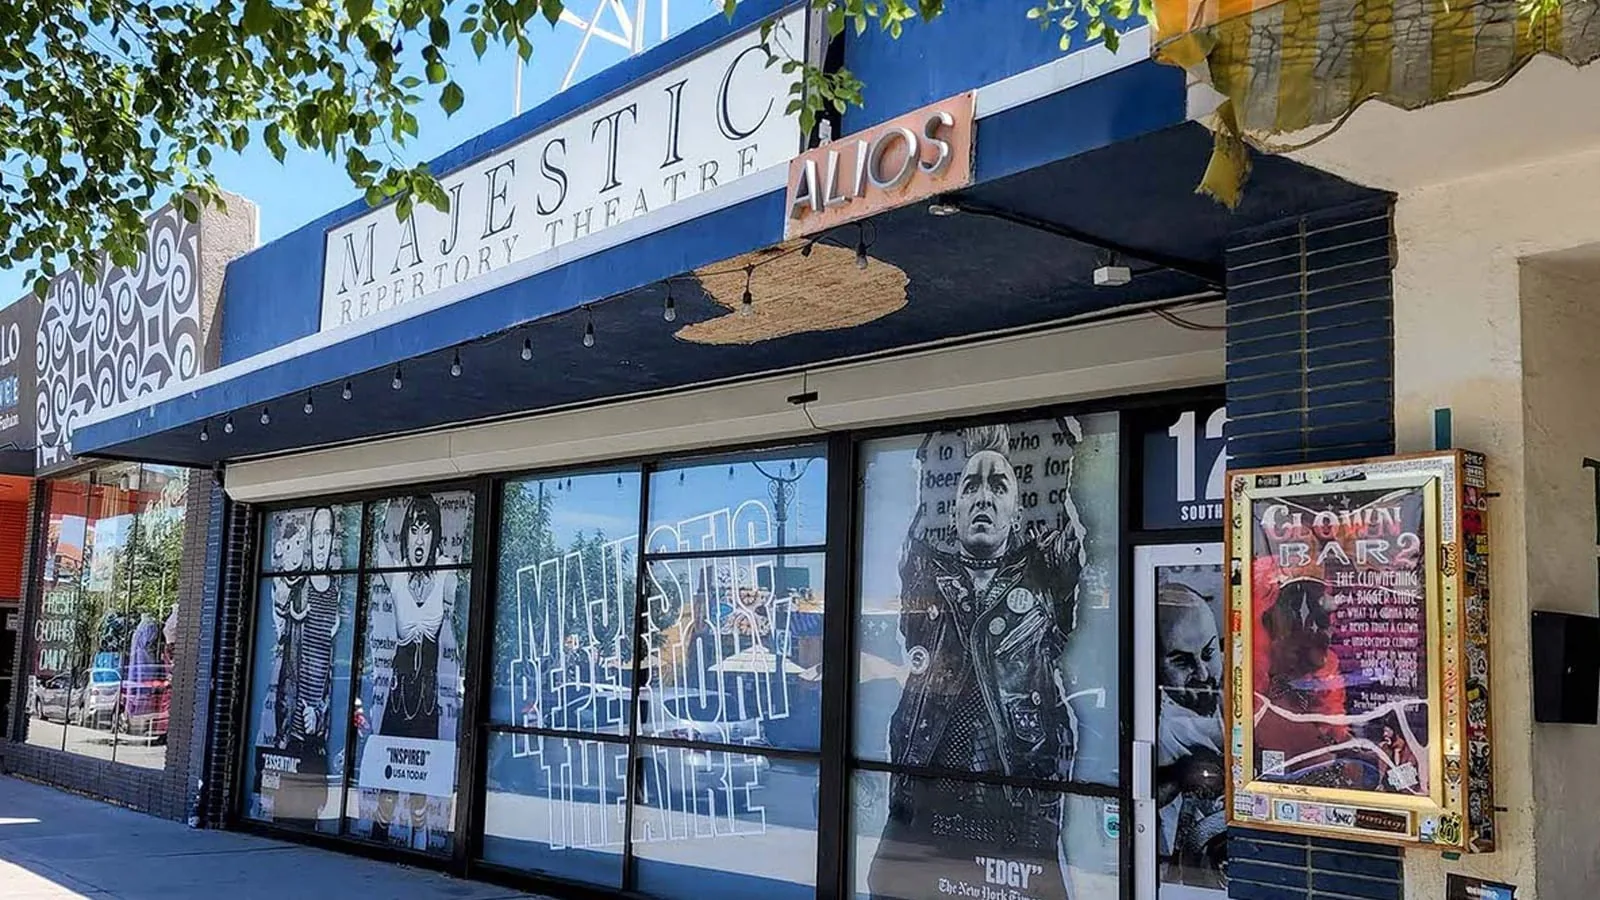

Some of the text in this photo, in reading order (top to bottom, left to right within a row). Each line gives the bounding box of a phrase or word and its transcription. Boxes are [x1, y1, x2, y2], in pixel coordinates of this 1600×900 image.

[337, 45, 776, 294] MAJESTIC
[790, 111, 955, 219] ALIOS
[340, 143, 759, 326] REPERTORY THEATRE
[1181, 503, 1223, 520] SOUTH
[516, 500, 776, 662] MAJESTIC
[1336, 571, 1355, 587] THE
[393, 770, 428, 781] USA TODAY
[938, 878, 957, 895] The
[959, 881, 981, 897] New
